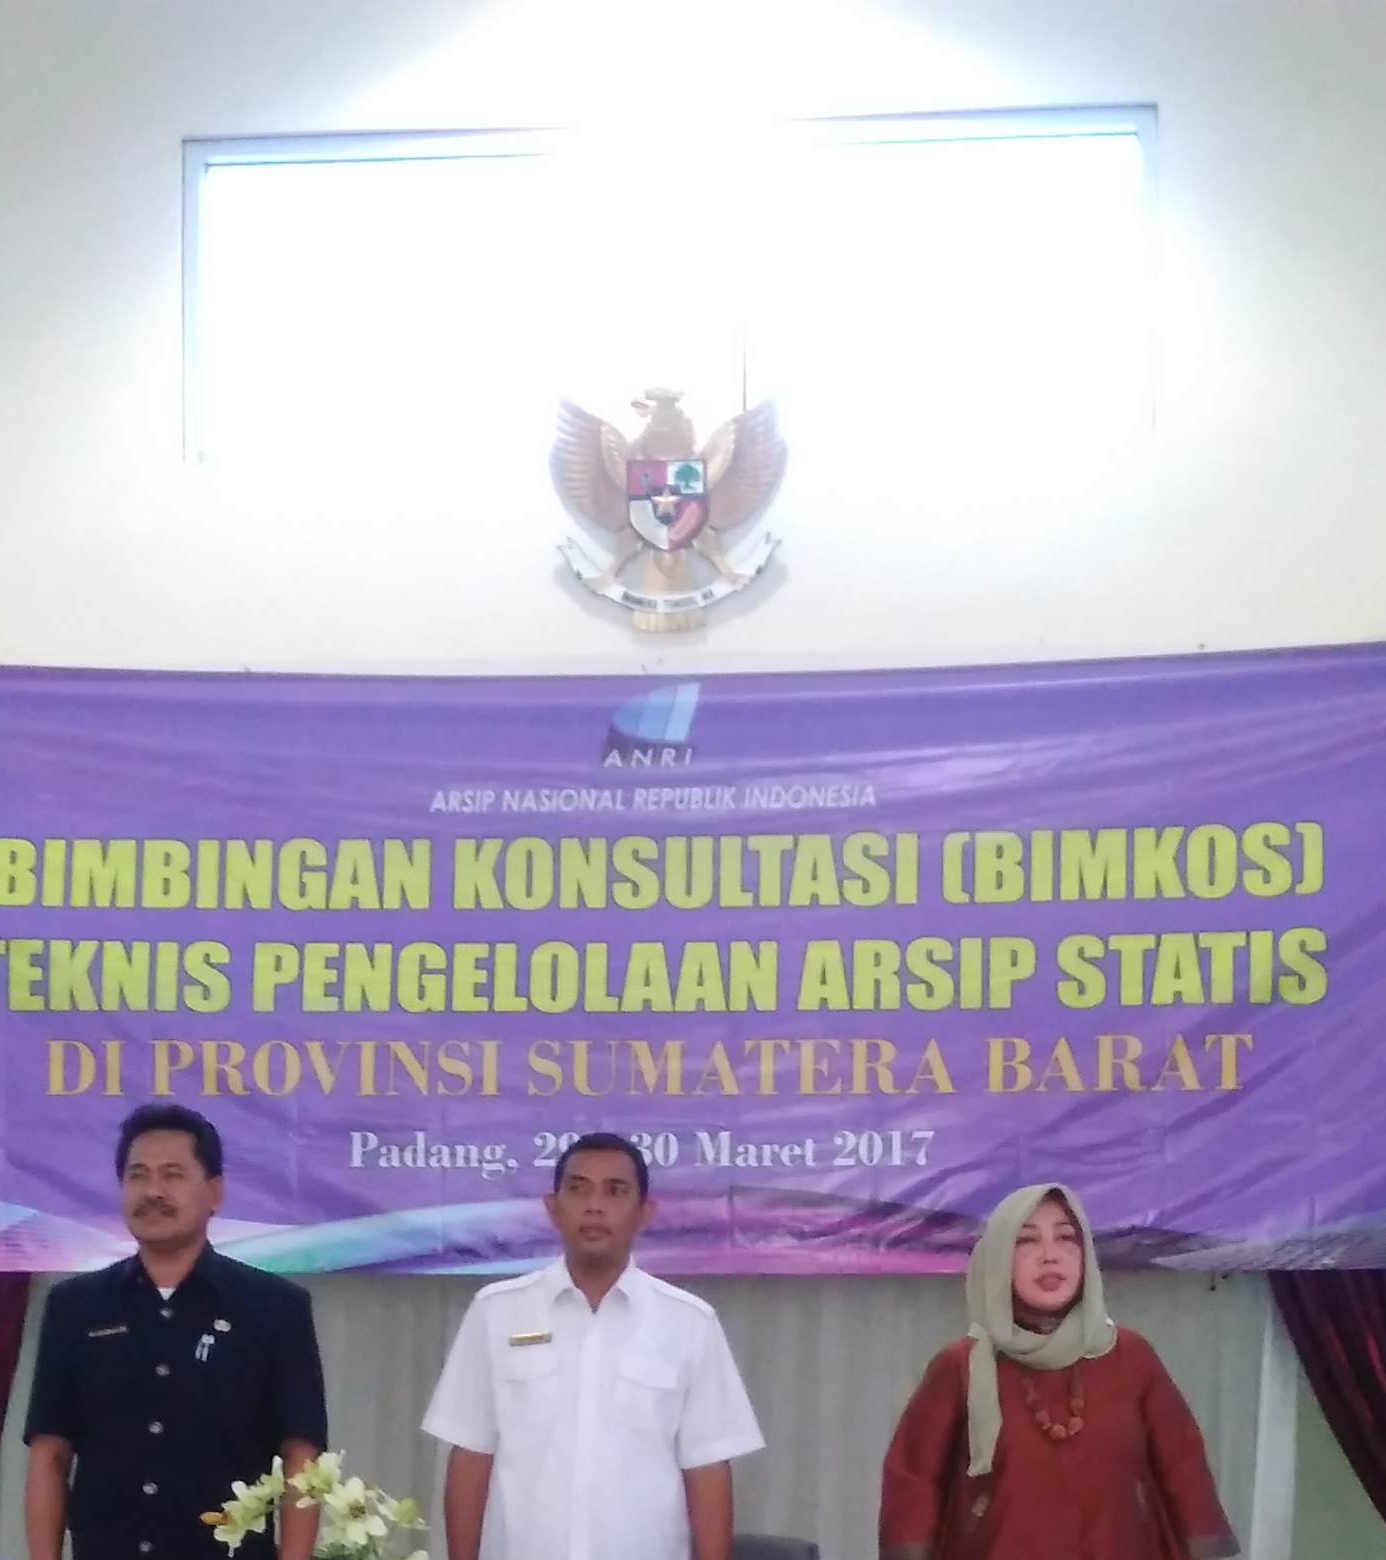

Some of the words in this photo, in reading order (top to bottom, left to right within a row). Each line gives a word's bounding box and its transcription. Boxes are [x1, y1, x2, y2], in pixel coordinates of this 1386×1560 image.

[603, 748, 692, 768] ANRI
[430, 789, 496, 813] ARSIP
[503, 788, 625, 812] NASIONAL
[633, 786, 737, 810] REPUBLIK
[744, 784, 877, 809] INDONESIA
[452, 831, 919, 910] KONSULTASI
[942, 822, 1325, 904] (BIMKOS)
[252, 941, 779, 1013] PENGELOLAAN
[797, 936, 1037, 1011] ARSIP
[1055, 928, 1328, 1009] STATIS
[46, 1039, 124, 1096] DI
[150, 1039, 502, 1097] PROVINSI
[527, 1038, 956, 1096] SUMATERA
[985, 1032, 1254, 1093] BARAT
[349, 1131, 519, 1181] Padang,
[693, 1131, 816, 1168] Maret
[832, 1129, 936, 1167] 2017
